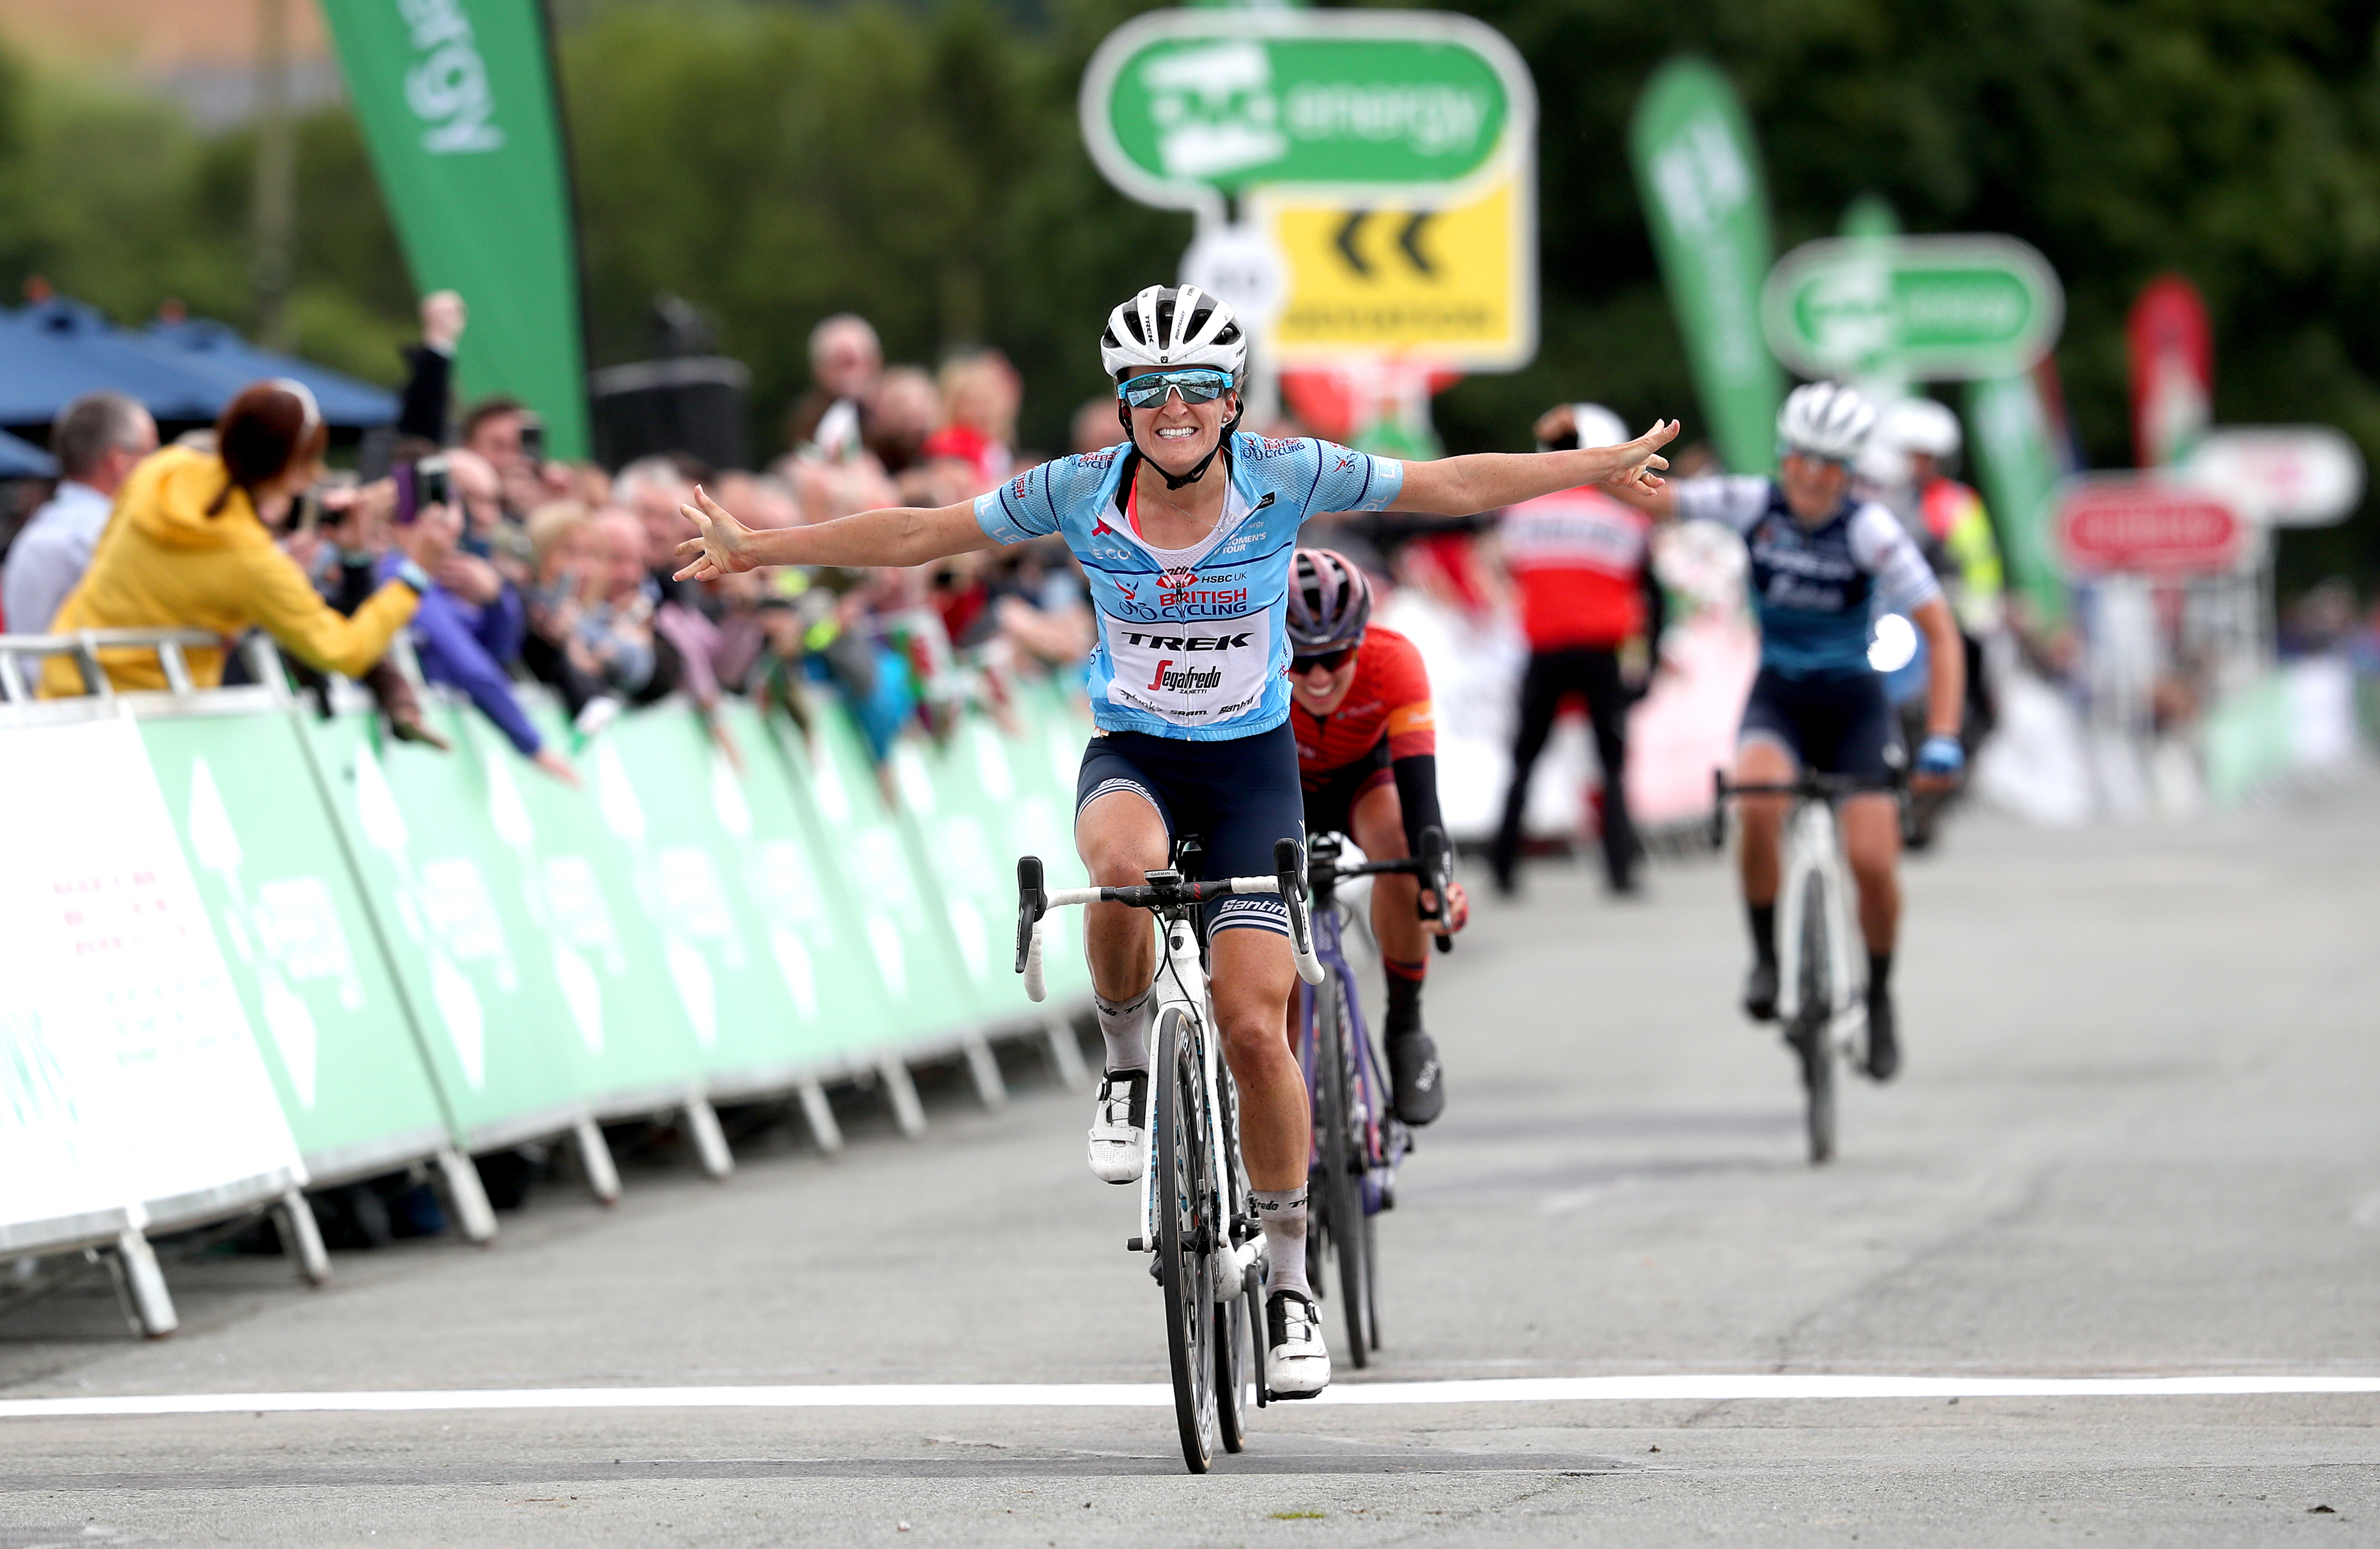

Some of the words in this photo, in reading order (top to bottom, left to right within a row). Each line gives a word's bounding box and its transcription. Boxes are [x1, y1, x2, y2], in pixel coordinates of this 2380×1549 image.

[1145, 315, 1156, 344] TREK
[1265, 442, 1306, 458] CYCLING
[1201, 575, 1232, 583] HSBC
[1234, 571, 1247, 581] UK
[1159, 587, 1247, 607] BRITISH
[1161, 601, 1247, 618] CYCLING
[1121, 631, 1256, 652] TREK
[1148, 660, 1221, 691] Segafredo
[1220, 899, 1287, 916] Santin
